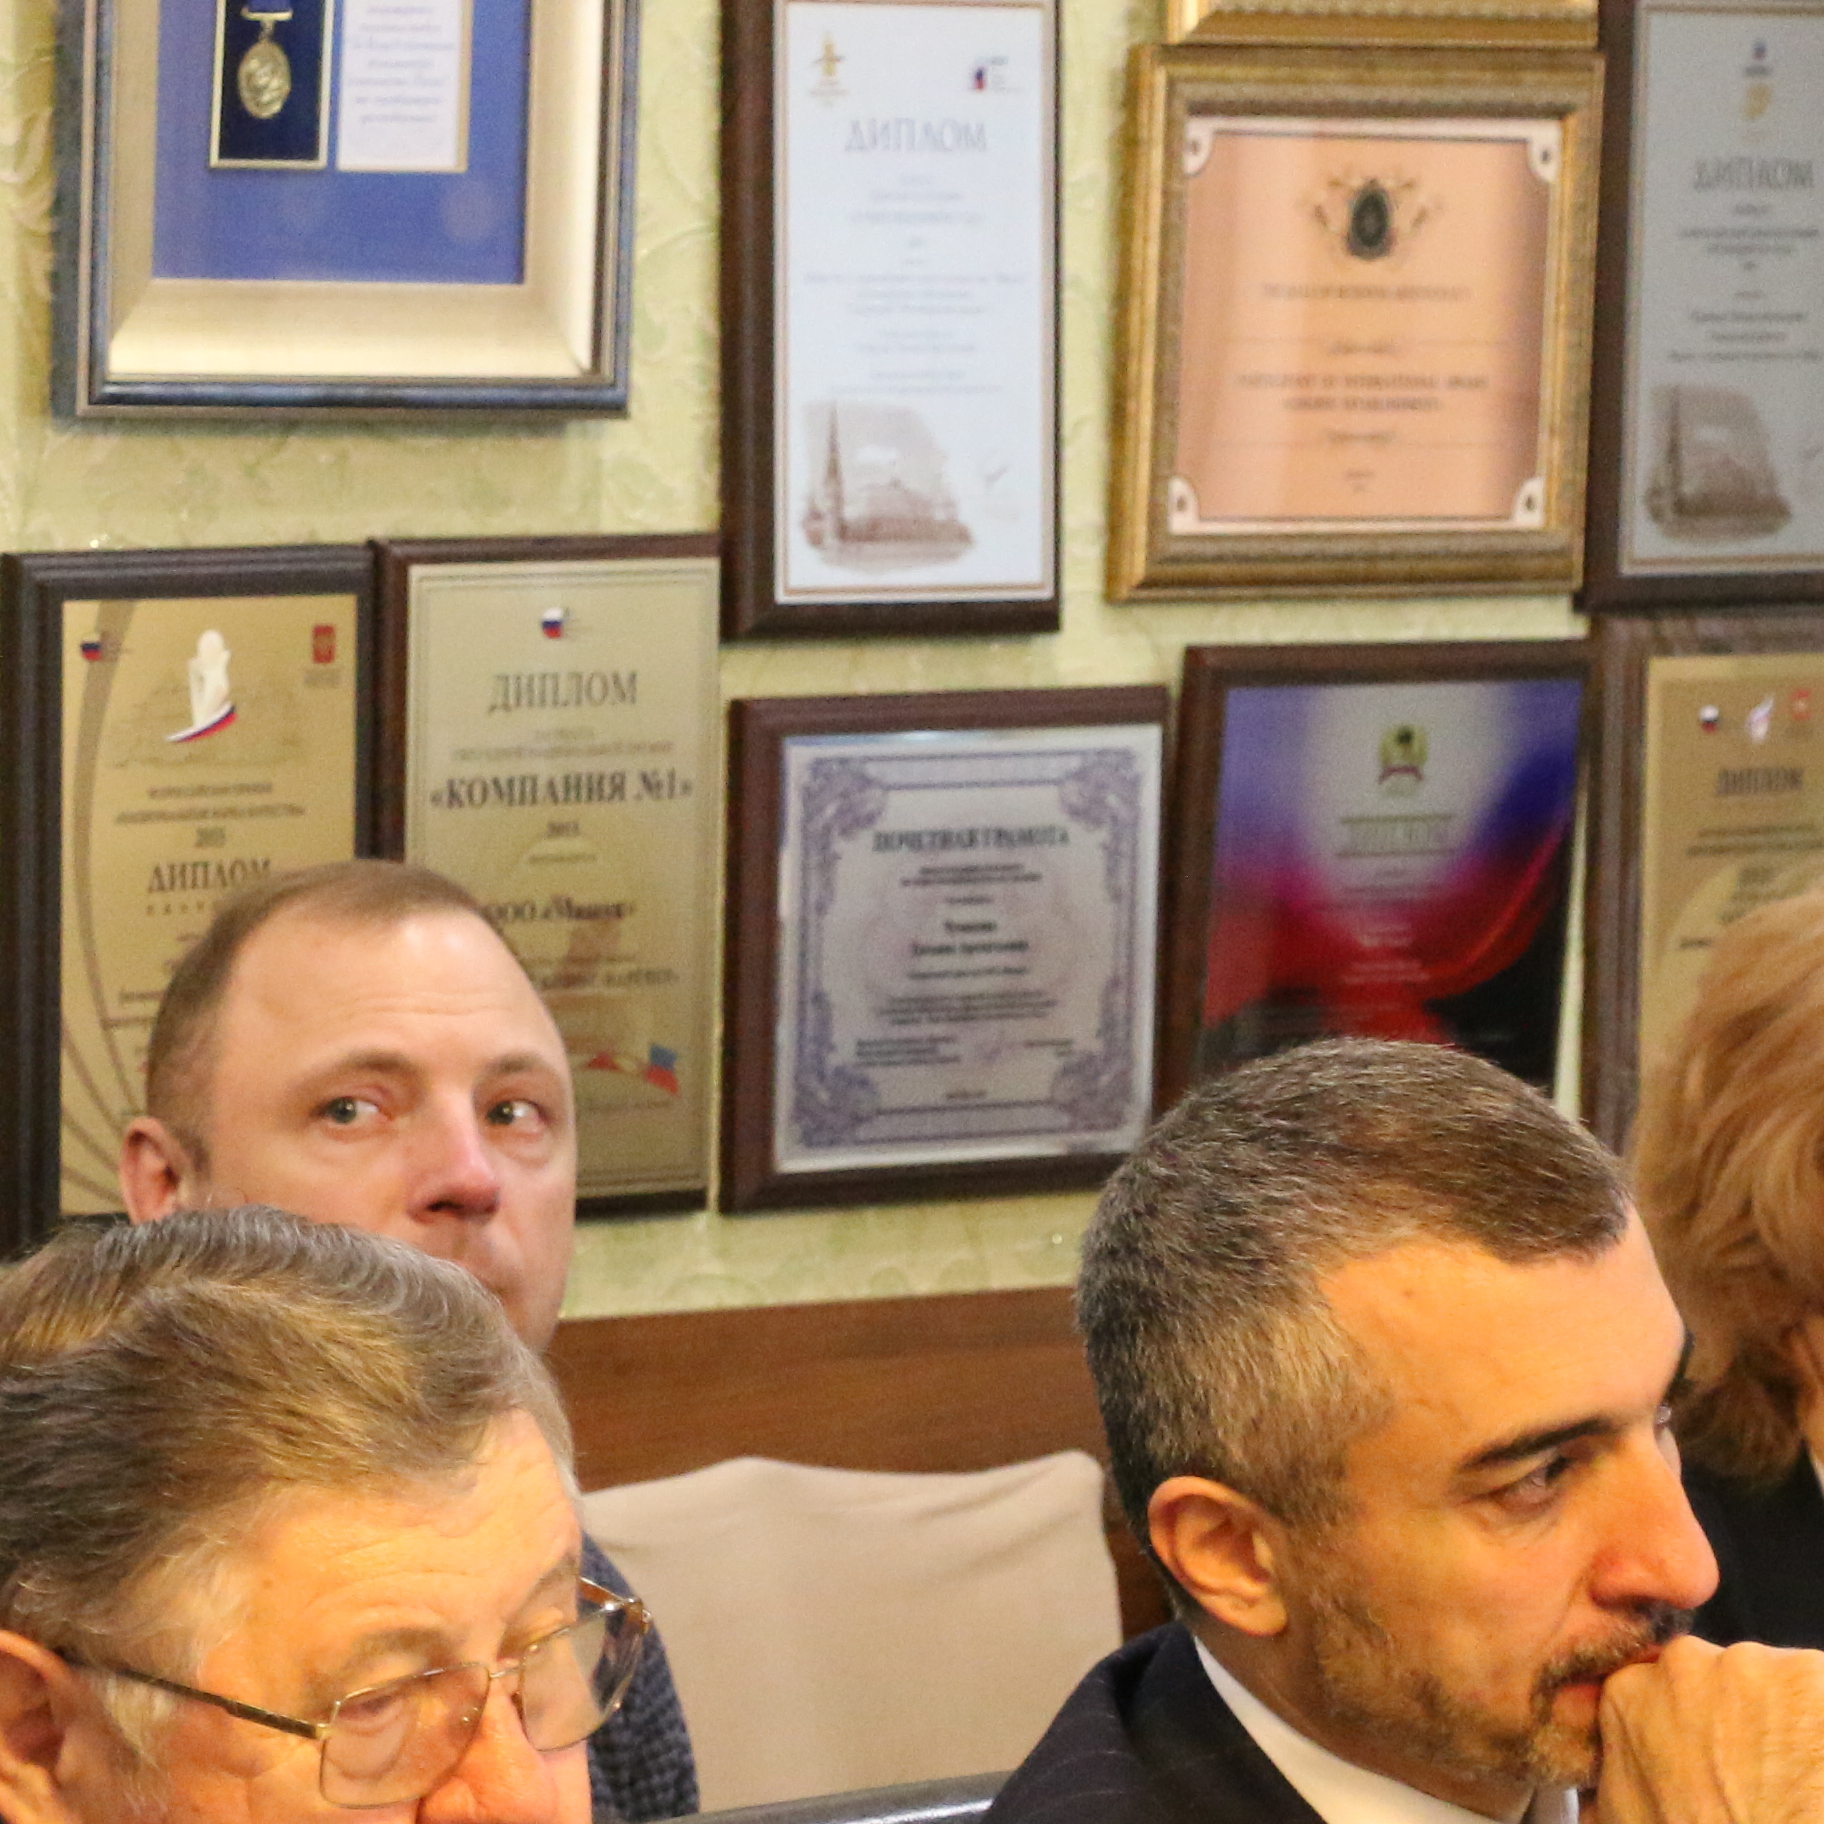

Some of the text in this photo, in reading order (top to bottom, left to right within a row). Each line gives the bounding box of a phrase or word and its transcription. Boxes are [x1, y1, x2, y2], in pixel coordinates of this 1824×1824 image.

[844, 117, 987, 151] ДИПЛОМ
[487, 668, 637, 716] ДИПЛОМ
[430, 766, 626, 810] «КОМПАНИЯ
